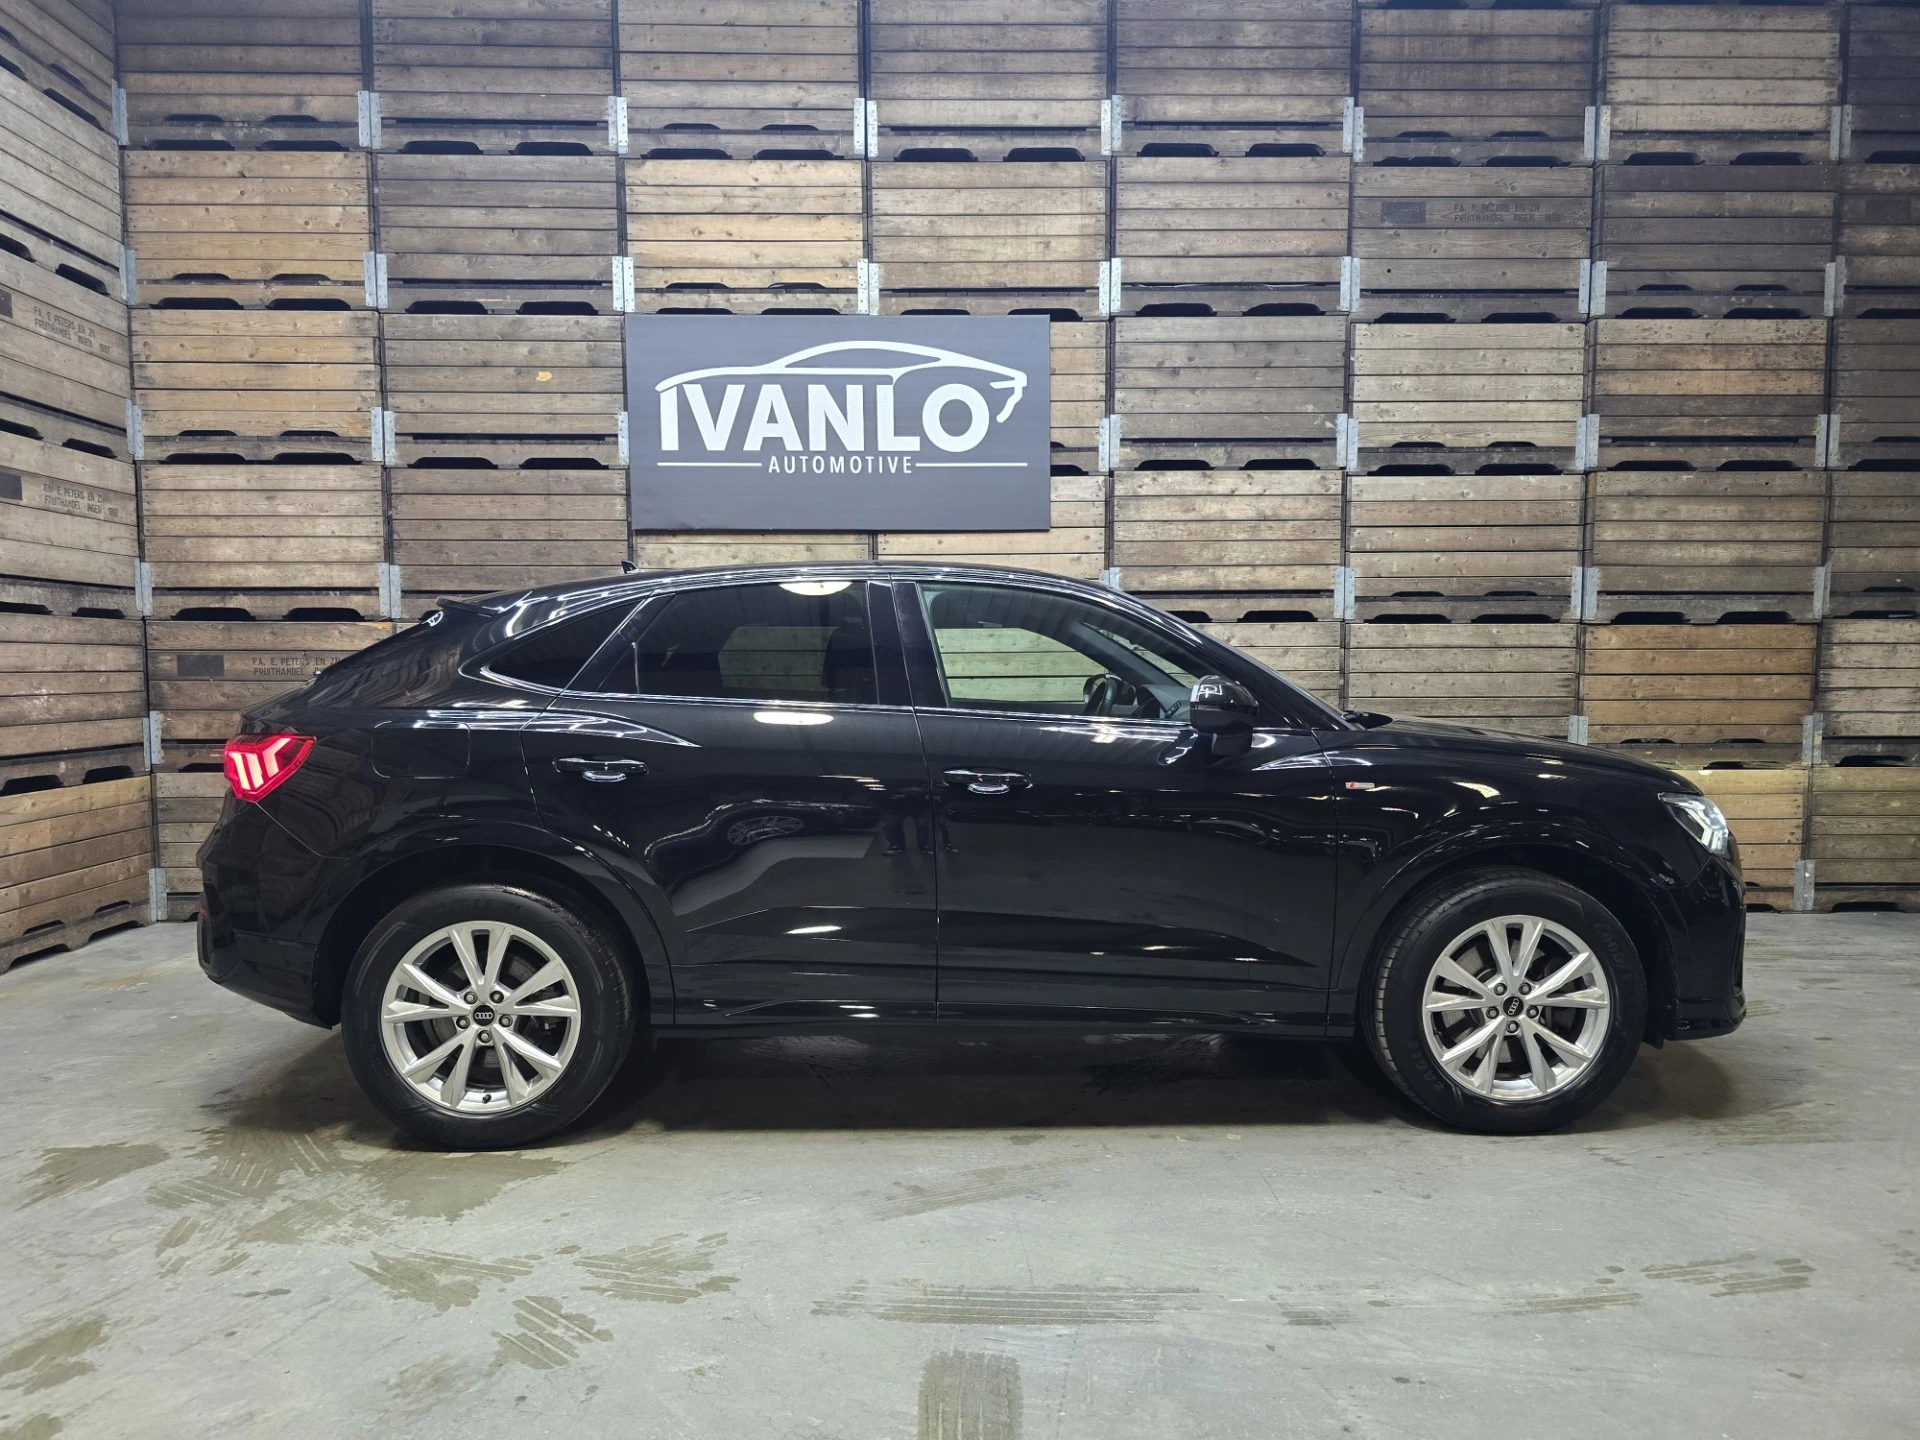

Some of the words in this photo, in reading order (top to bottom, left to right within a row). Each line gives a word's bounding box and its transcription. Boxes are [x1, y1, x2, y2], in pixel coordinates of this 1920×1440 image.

[659, 382, 990, 453] IVANLO
[768, 455, 912, 474] AUTOMOTIVE
[281, 657, 310, 666] PETERS
[315, 657, 326, 666] EN
[254, 667, 305, 676] FRUITHANDEL
